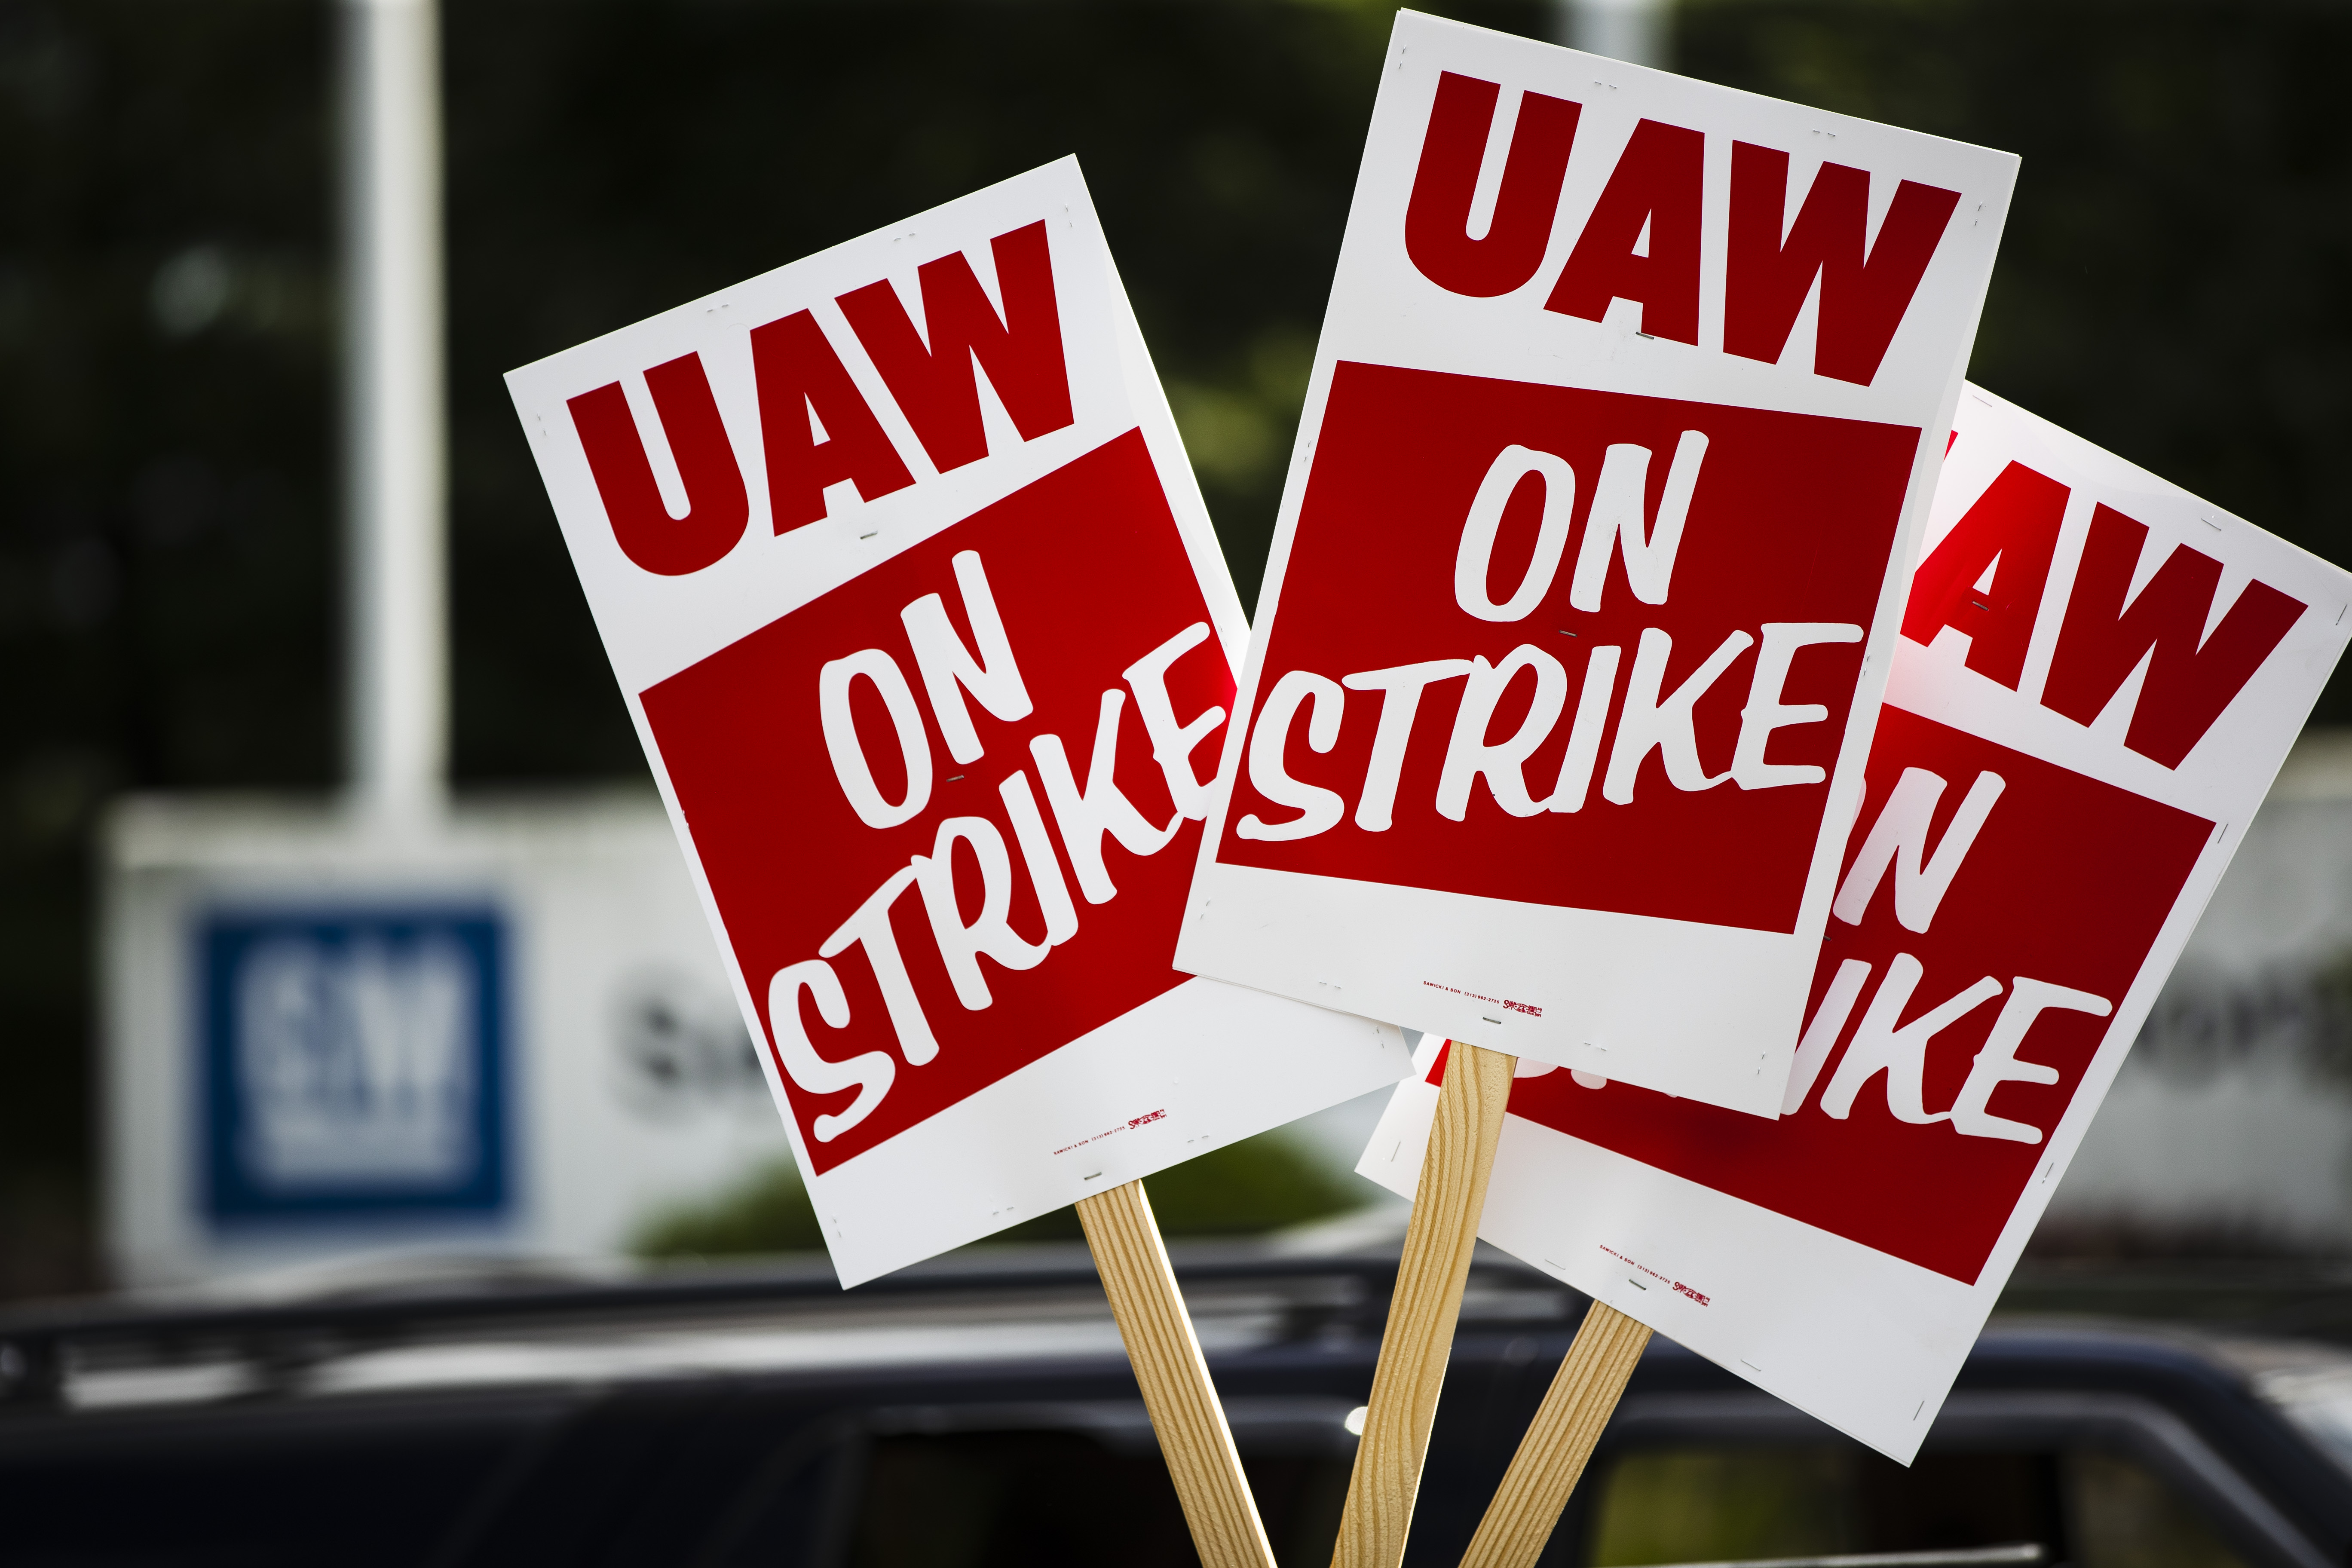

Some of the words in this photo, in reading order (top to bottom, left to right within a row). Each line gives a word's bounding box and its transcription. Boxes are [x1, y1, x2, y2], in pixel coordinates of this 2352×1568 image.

[1405, 71, 1961, 387] UAW
[567, 219, 1074, 576] UAW
[1455, 430, 1709, 622] ON
[1900, 431, 2307, 771] AW
[820, 550, 1033, 829] ON
[1237, 622, 1863, 841] STRIKE
[769, 622, 1226, 1142] STRIKE
[1833, 767, 2006, 934] N
[1424, 981, 1444, 989] SAWICKI
[1781, 952, 2112, 1144] IKE
[1054, 1146, 1072, 1155] SAWICKI
[1600, 1245, 1619, 1257] SAWICKI
